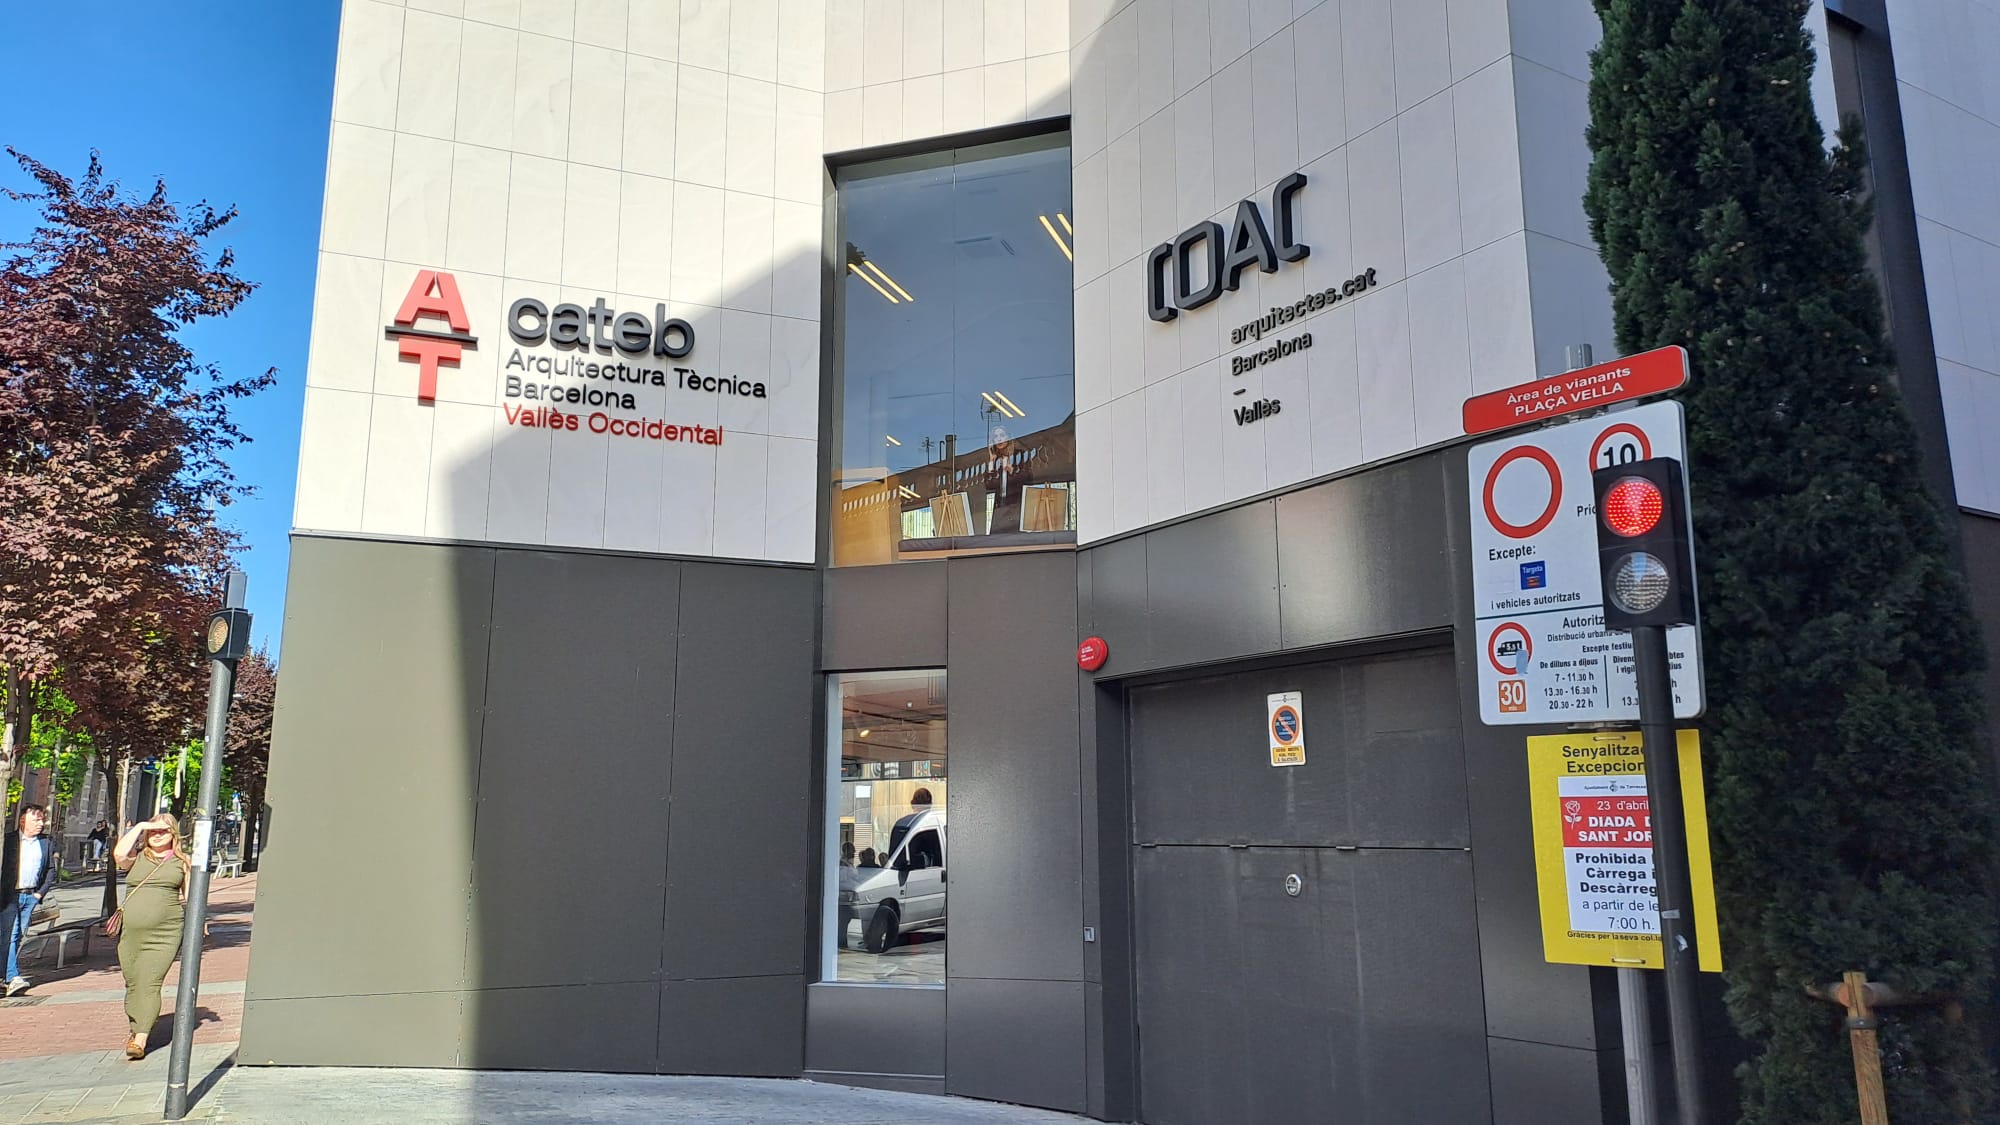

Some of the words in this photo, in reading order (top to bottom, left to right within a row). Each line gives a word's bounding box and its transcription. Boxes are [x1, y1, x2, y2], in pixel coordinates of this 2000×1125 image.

[1147, 172, 1311, 323] COAC
[1230, 266, 1377, 345] arquitectes.cat
[507, 297, 696, 360] cateb
[1231, 332, 1313, 377] Barcelona
[505, 348, 666, 387] Arquitectura
[673, 366, 768, 399] Tècnica
[1543, 384, 1561, 396] de
[1566, 367, 1631, 390] vianants
[504, 375, 637, 410] Barcelona
[1515, 396, 1567, 417] PLAÇA
[1571, 382, 1624, 403] VELLA
[1233, 397, 1281, 427] Vallès
[503, 402, 580, 431] Vallès
[588, 411, 724, 446] Occidental
[1603, 443, 1637, 468] 10
[1576, 503, 1597, 517] Prio
[1488, 544, 1536, 560] Excepte:
[1496, 597, 1531, 609] vehicles
[1533, 591, 1581, 606] autoritzats
[1562, 614, 1605, 628] Autoritz
[1547, 631, 1585, 642] Distribució
[1582, 643, 1609, 653] Excepte
[1611, 641, 1632, 650] festiu
[1550, 659, 1571, 669] dilluns
[1578, 658, 1598, 667] dijous
[1613, 655, 1634, 663] Diven
[1668, 651, 1684, 660] btes
[1555, 673, 1560, 682] 7
[1567, 672, 1586, 682] 11.30
[1589, 671, 1594, 680] h
[1672, 678, 1677, 688] h
[1501, 681, 1525, 706] 30
[1544, 687, 1563, 697] 13.30
[1570, 685, 1590, 695] 16.30
[1592, 684, 1598, 694] h
[1549, 700, 1569, 710] 20.30
[1576, 699, 1586, 708] 22
[1588, 698, 1594, 708] h
[1622, 696, 1639, 706] 13.3
[1675, 694, 1681, 703] h
[1562, 744, 1645, 760] Senyalitza
[1567, 759, 1646, 775] Excepcion
[1597, 800, 1611, 811] 23
[1616, 800, 1649, 810] d'abril
[1588, 815, 1636, 827] DIADA
[1578, 830, 1619, 842] SANT
[1623, 830, 1652, 842] JOR
[1575, 852, 1647, 864] Prohibida
[1586, 867, 1646, 881] Càrrega
[1580, 881, 1657, 897] Descàrreg
[1582, 900, 1589, 909] a
[1593, 899, 1624, 912] partir
[1628, 900, 1644, 911] de
[1607, 916, 1637, 929] 7:00
[1642, 918, 1655, 930] h.
[1567, 931, 1595, 939] Gràcies
[1598, 933, 1610, 941] per
